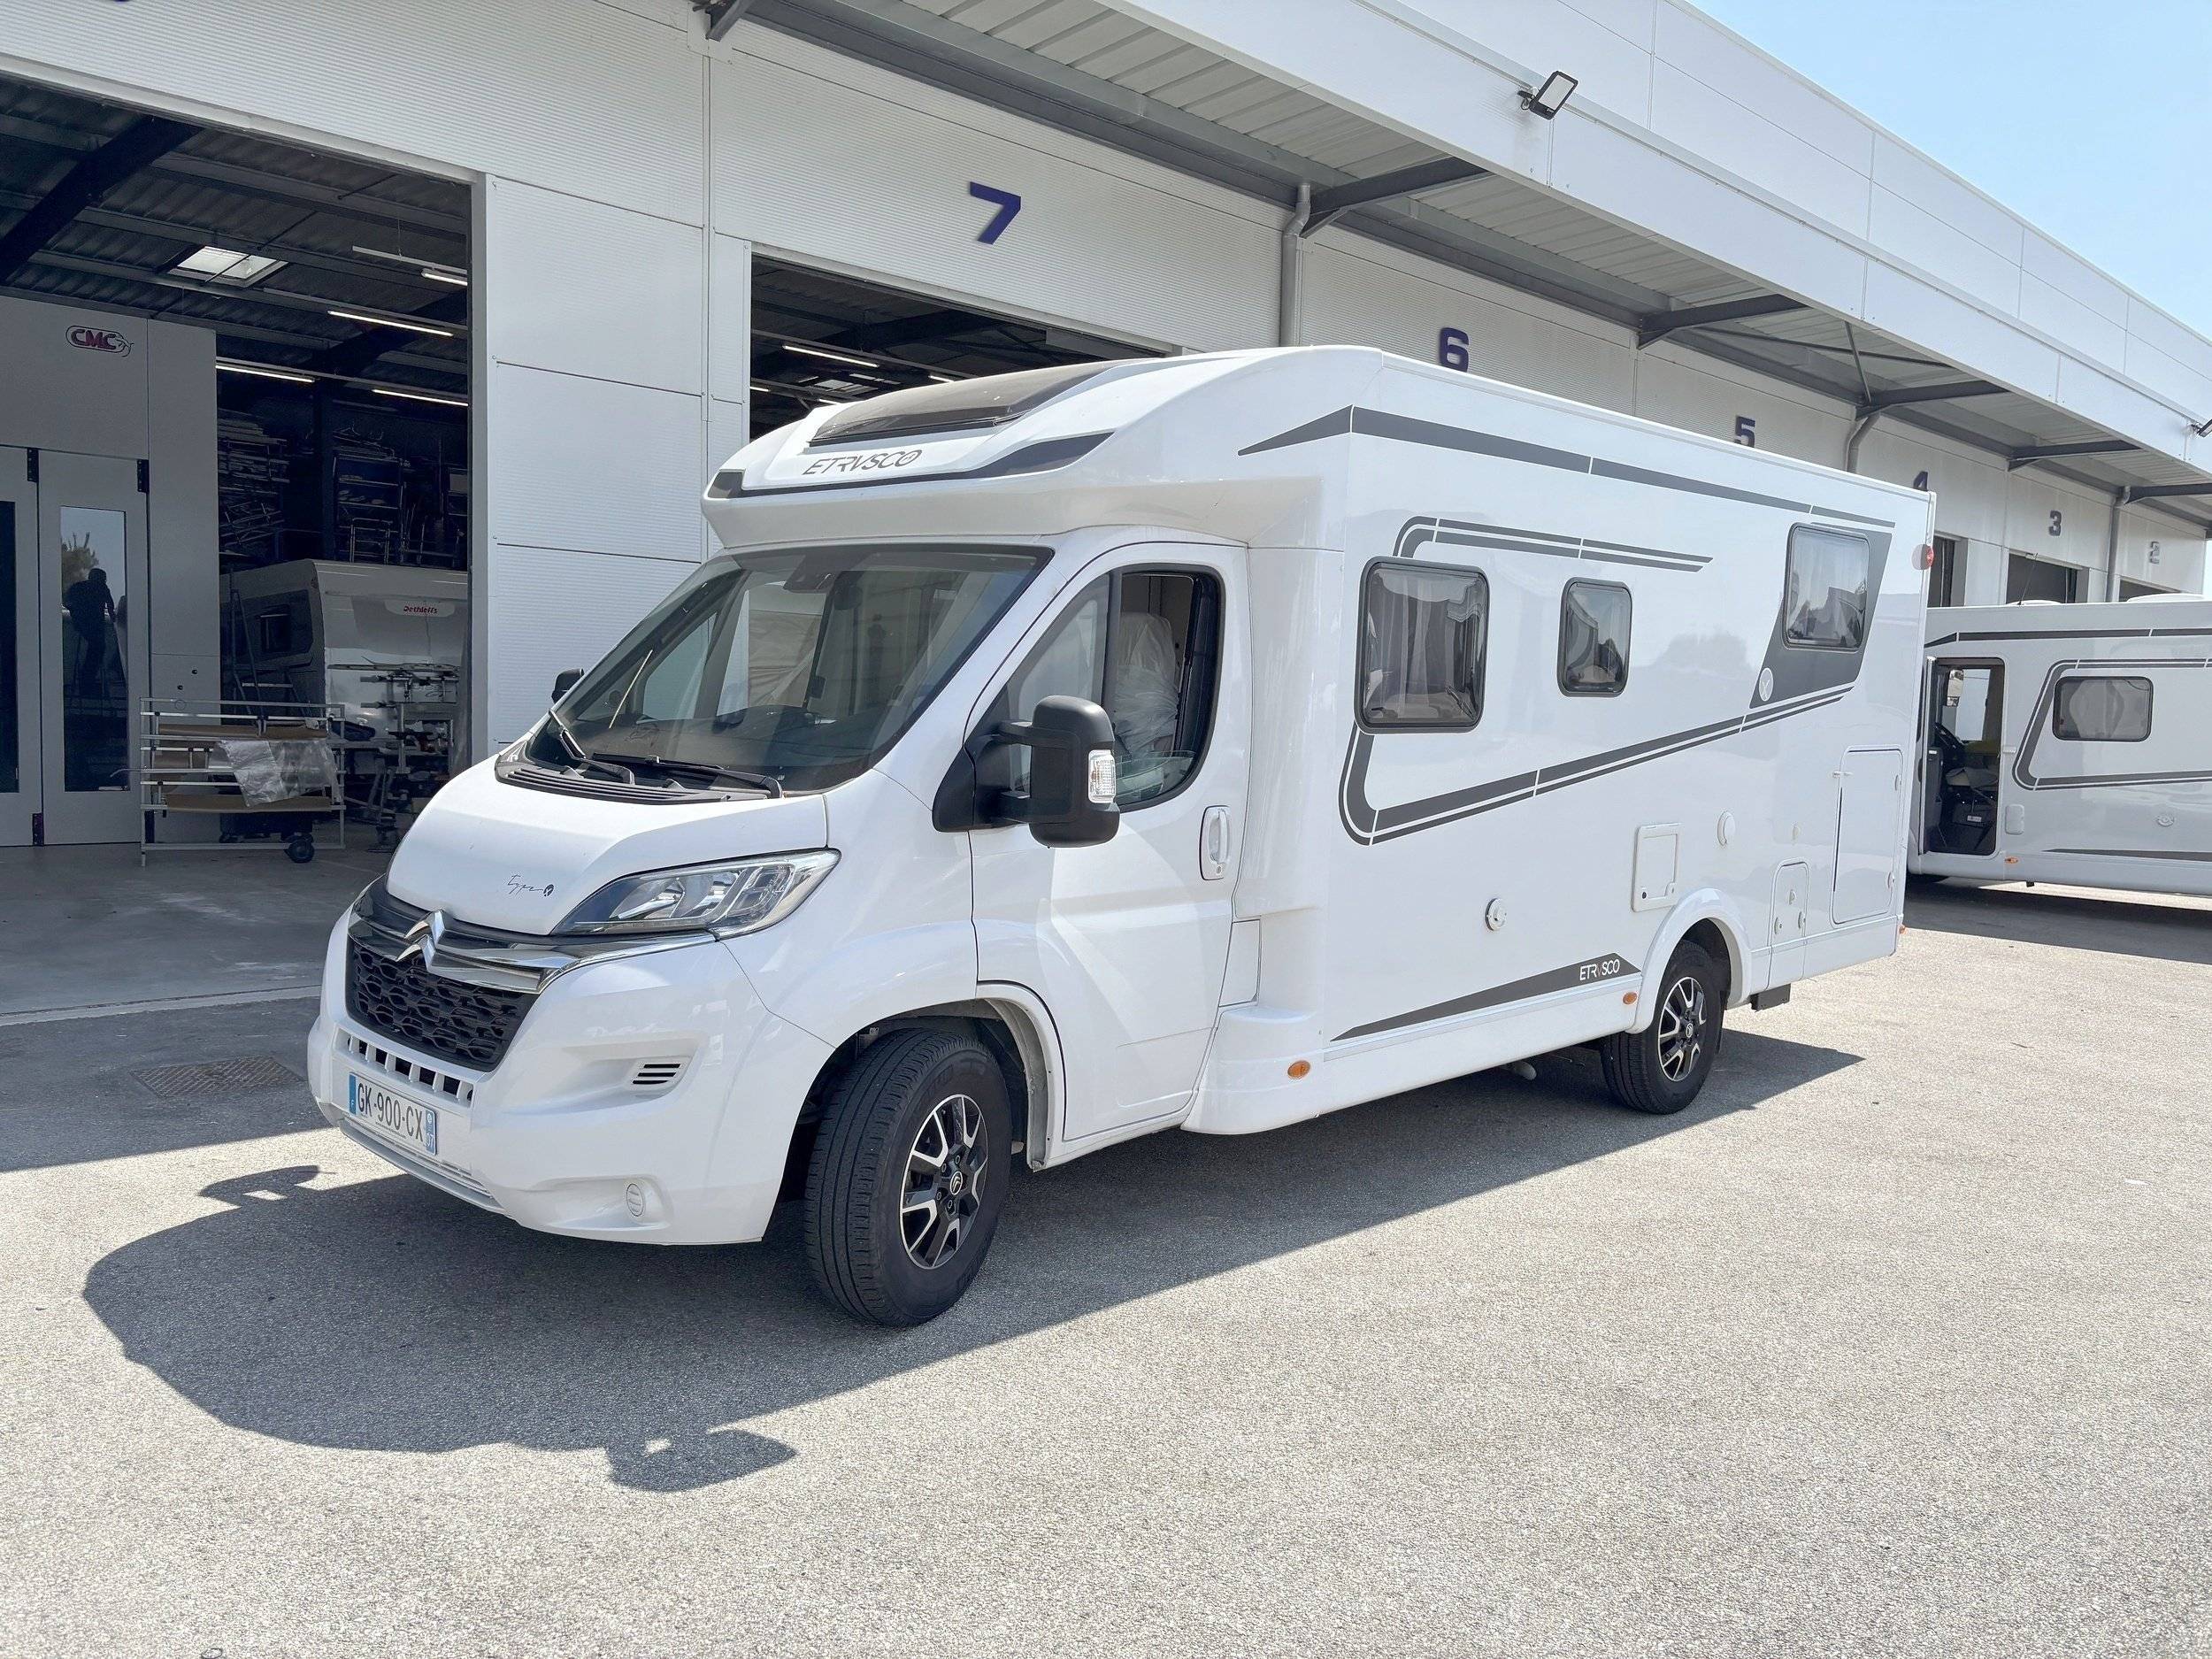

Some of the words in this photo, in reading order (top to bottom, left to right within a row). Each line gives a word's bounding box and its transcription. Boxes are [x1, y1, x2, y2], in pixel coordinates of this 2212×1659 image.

[969, 180, 1022, 246] 7
[70, 328, 117, 350] CMC
[1439, 326, 1470, 373] 6
[1734, 415, 1755, 449] 5
[1912, 470, 1929, 492] 4
[2048, 510, 2062, 536] 3
[2149, 541, 2160, 565] 2
[357, 1082, 423, 1142] GK-900-CX
